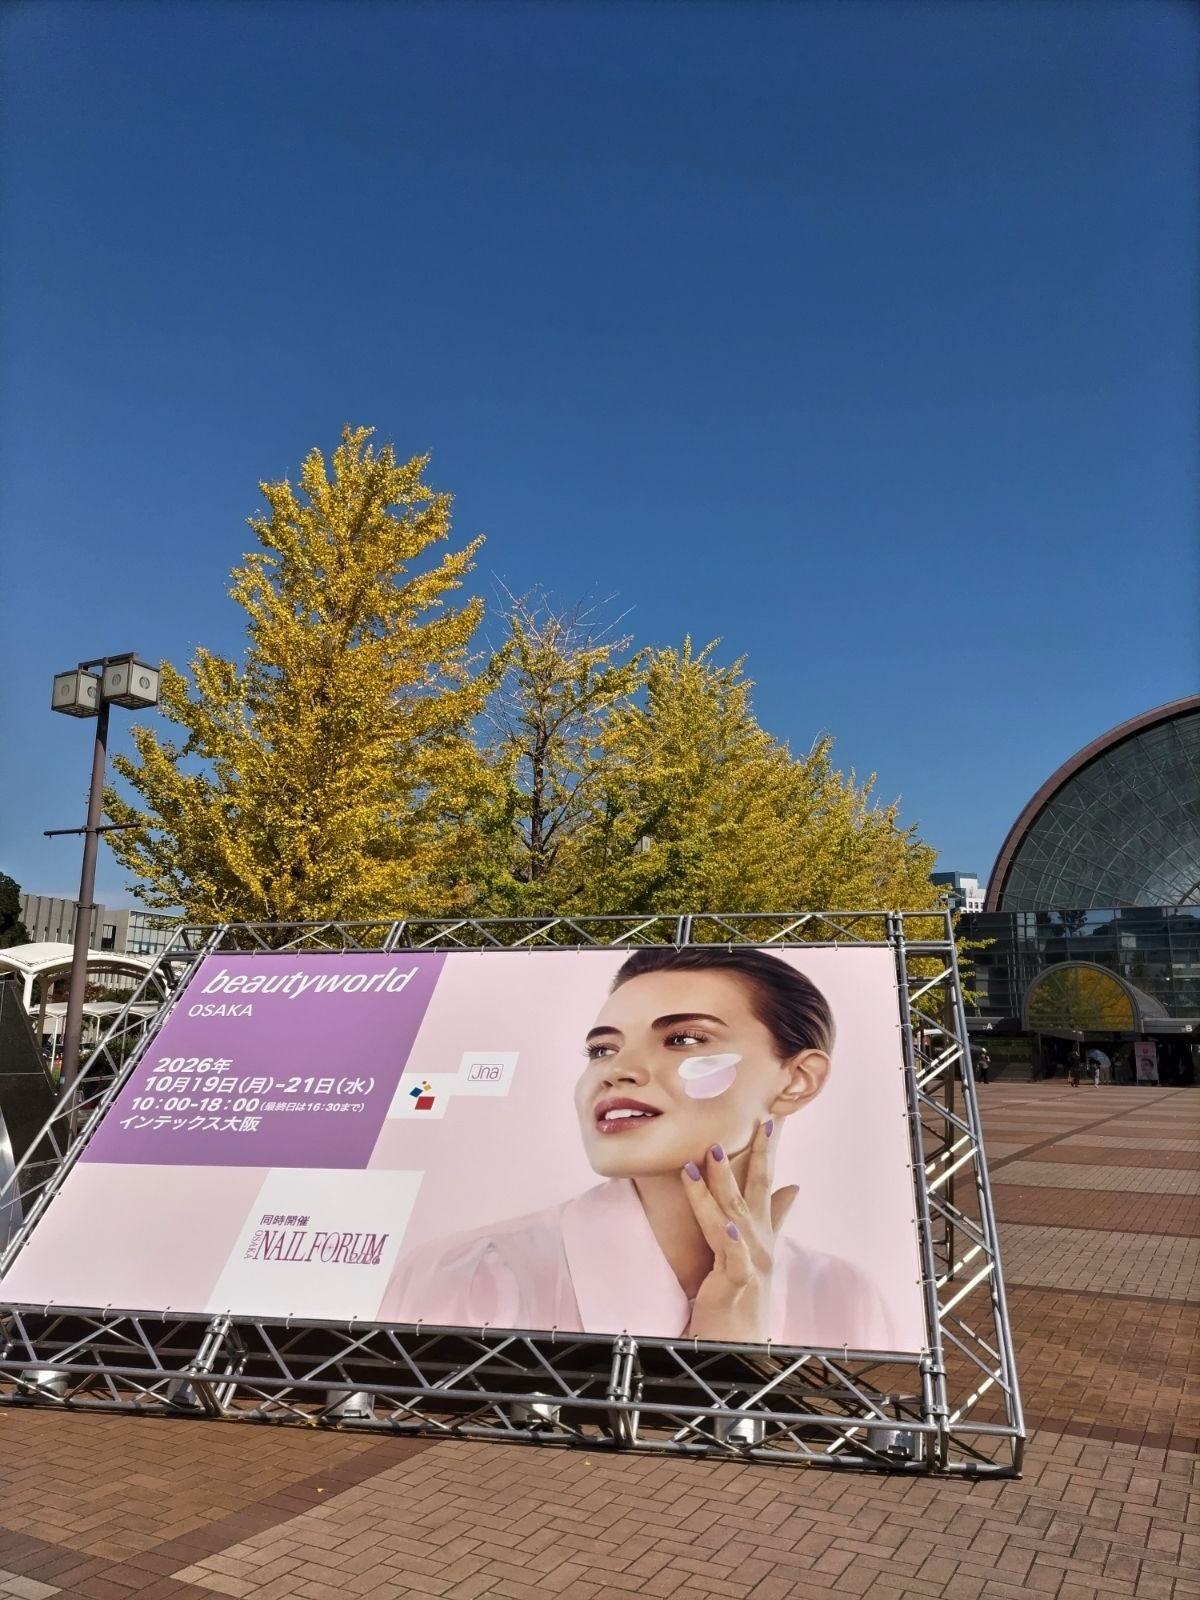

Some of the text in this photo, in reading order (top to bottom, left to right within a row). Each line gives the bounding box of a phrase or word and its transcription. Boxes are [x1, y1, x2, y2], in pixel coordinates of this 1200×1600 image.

[200, 967, 419, 999] beautyworld
[188, 1004, 253, 1018] OSAKA
[153, 1057, 233, 1074] 2026年
[119, 1115, 262, 1132] インテックス大阪
[259, 1214, 310, 1227] 同時開催
[252, 1230, 390, 1264] NAIL FORUM
